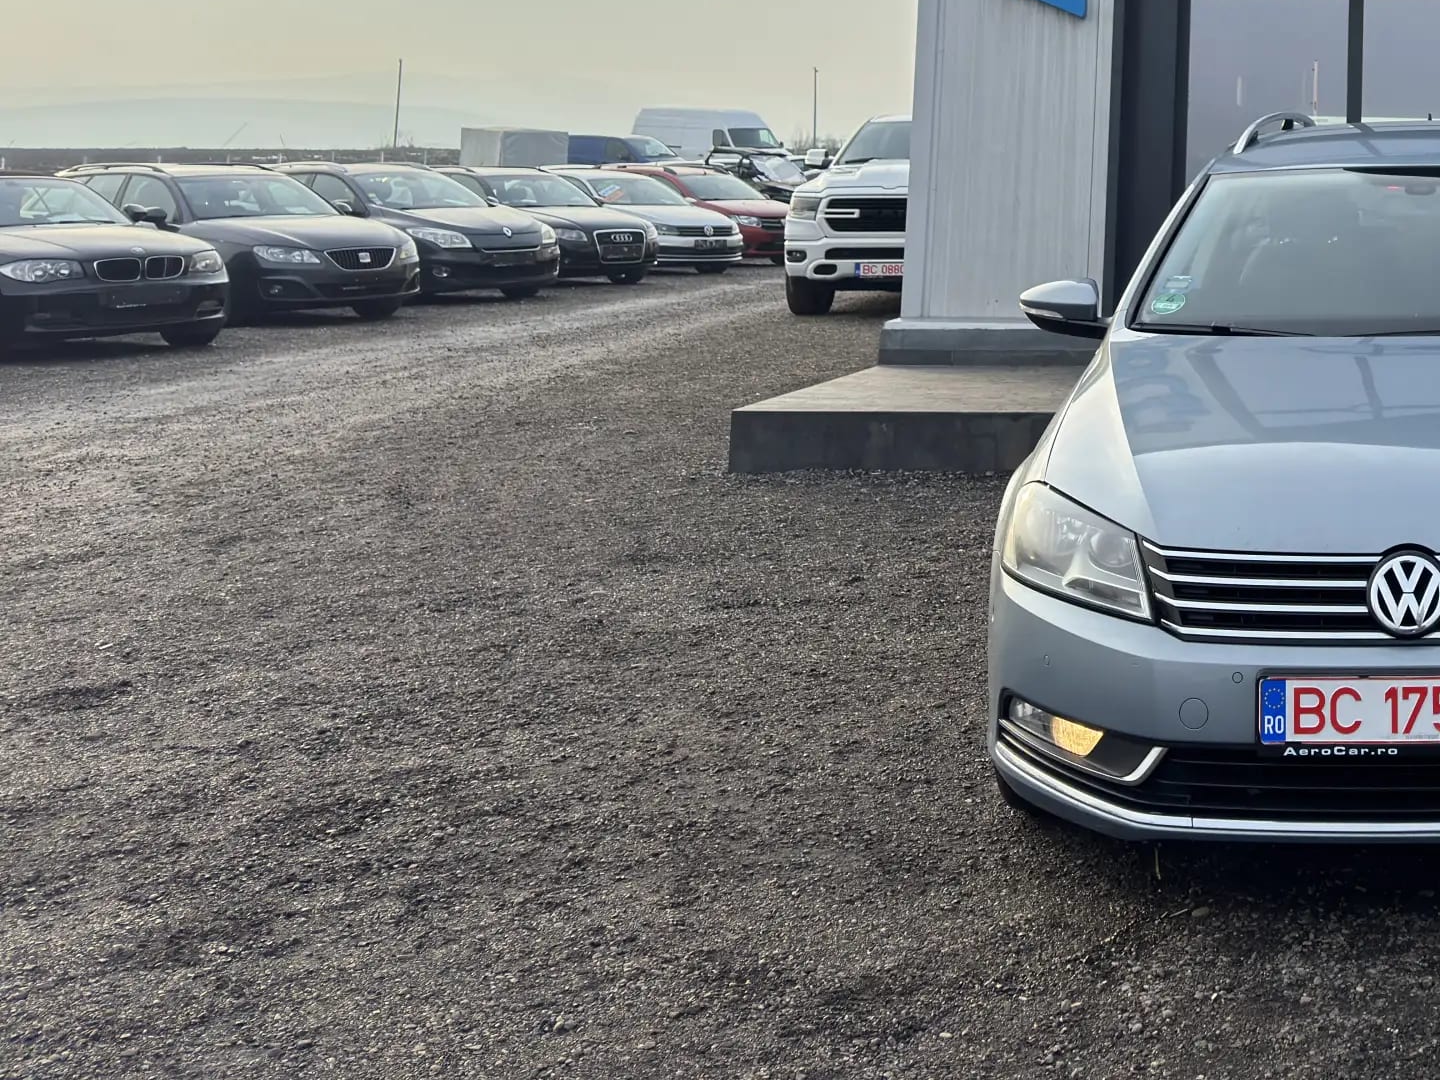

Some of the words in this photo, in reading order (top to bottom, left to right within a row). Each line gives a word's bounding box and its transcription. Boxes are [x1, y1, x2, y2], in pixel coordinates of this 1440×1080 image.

[862, 264, 878, 275] BC
[1292, 686, 1363, 735] BC
[1263, 715, 1285, 735] RO
[1283, 745, 1399, 757] AeroCar.ro
